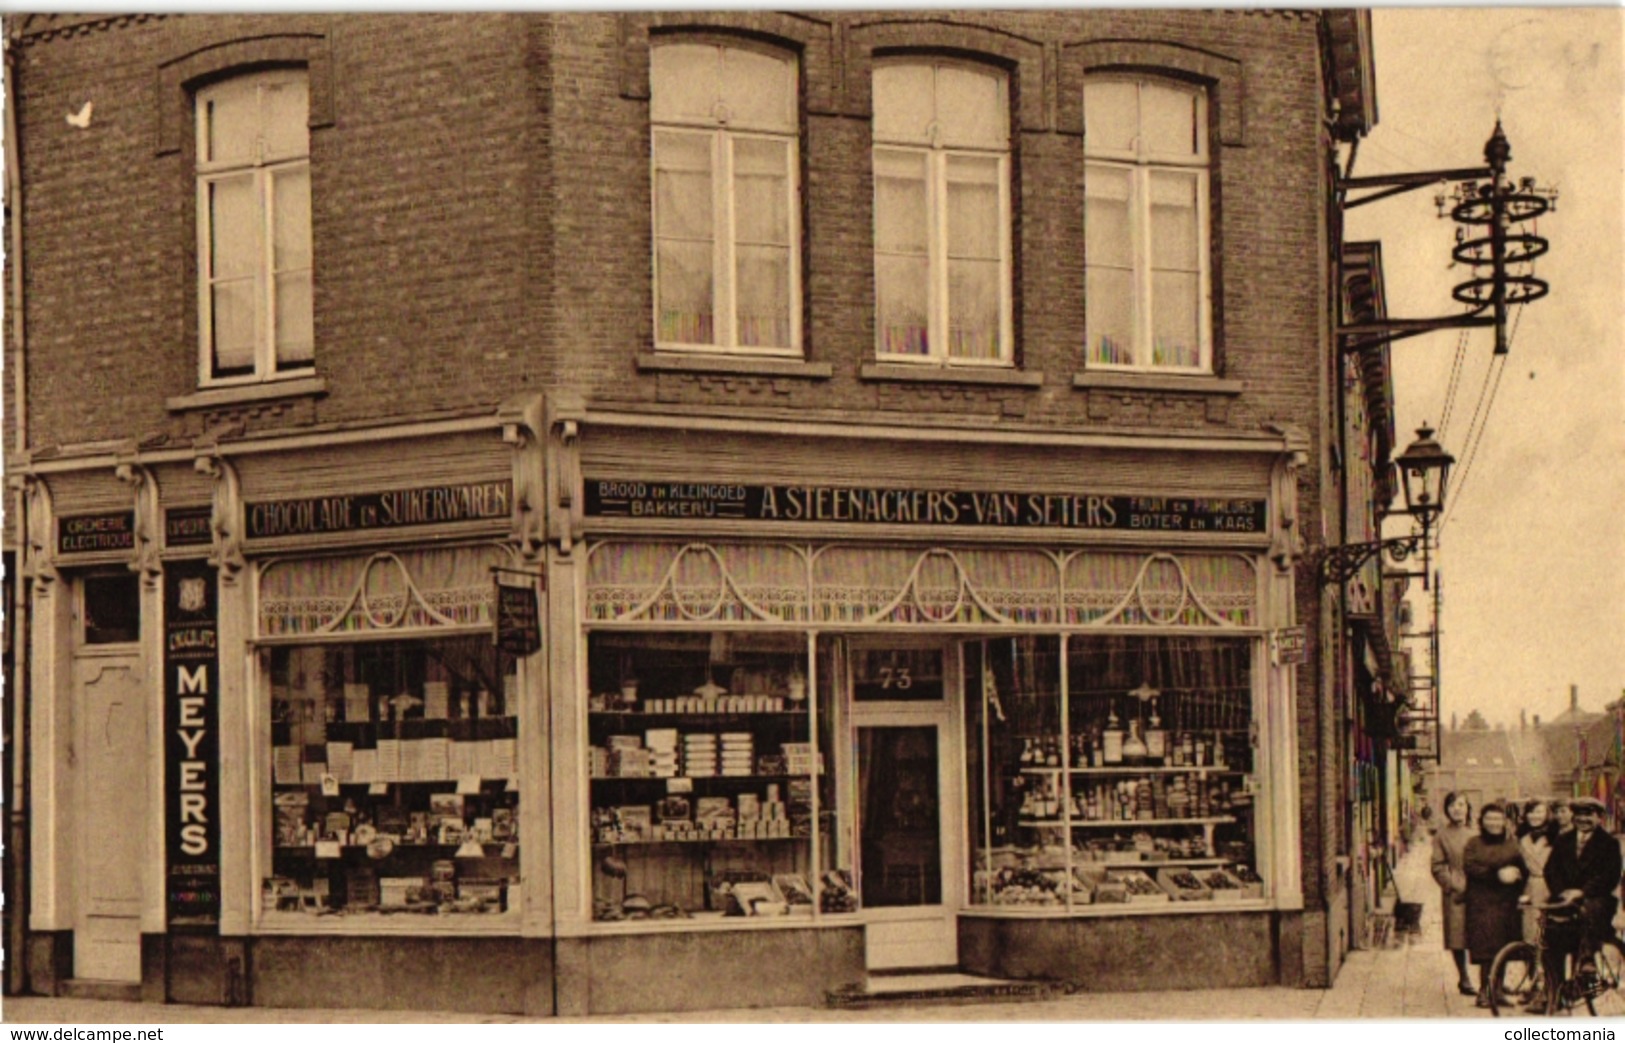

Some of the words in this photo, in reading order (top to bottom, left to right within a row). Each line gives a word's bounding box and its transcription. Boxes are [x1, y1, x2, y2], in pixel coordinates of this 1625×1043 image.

[599, 481, 647, 498] BROOD
[669, 483, 747, 501] KLEINGOED
[251, 495, 355, 536] CHOCOLADE
[380, 482, 507, 526] SUIKERWAREN
[1026, 493, 1118, 528] SETERS
[1130, 514, 1182, 529] BOTER
[1214, 515, 1255, 531] KAAS
[879, 667, 911, 688] 73
[177, 664, 208, 855] MEYERS
